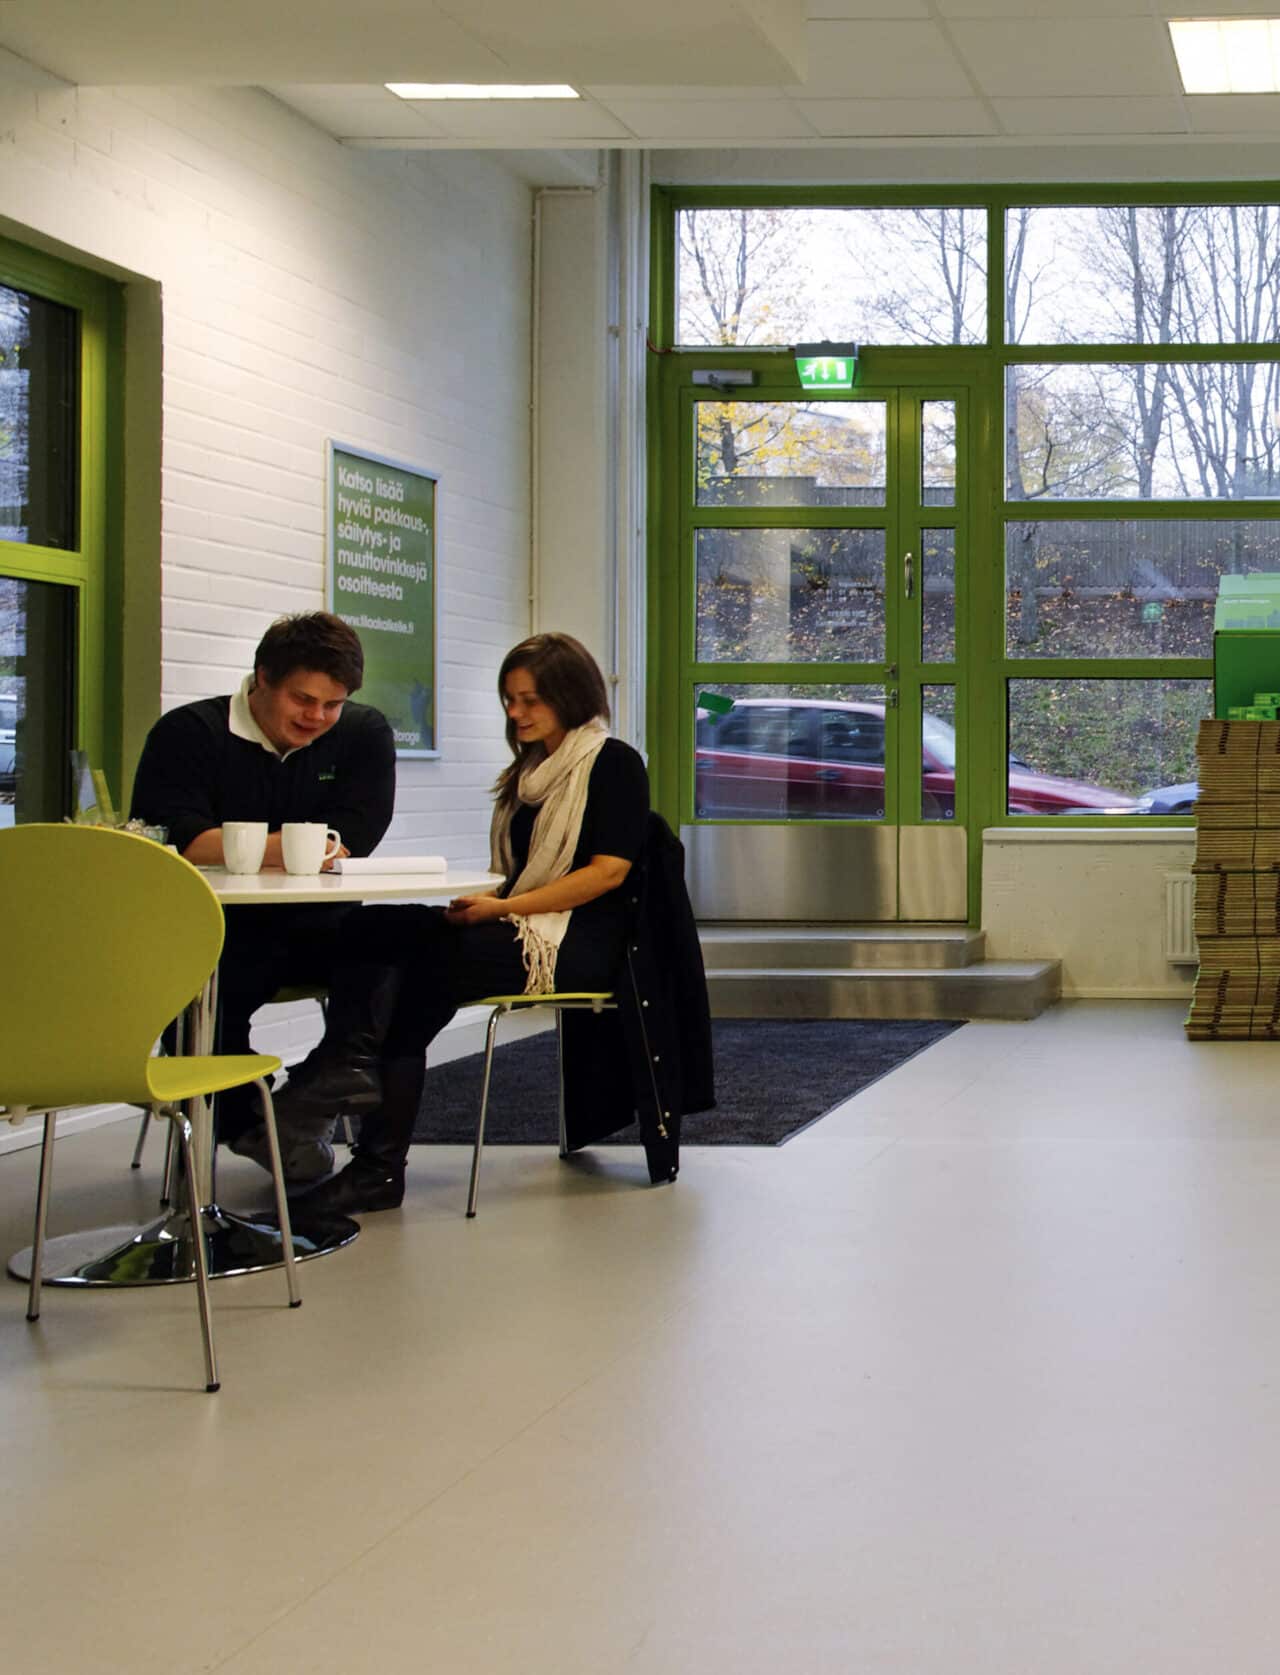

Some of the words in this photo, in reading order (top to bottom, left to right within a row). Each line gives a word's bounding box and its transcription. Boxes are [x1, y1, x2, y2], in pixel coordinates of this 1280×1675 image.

[338, 466, 373, 493] Katso
[376, 477, 404, 503] lisää
[338, 492, 371, 518] hyviä
[374, 506, 429, 536] pakkaus-,
[338, 518, 387, 549] säilytys-
[388, 531, 402, 554] ja
[338, 549, 428, 584] muuttovinkkejä
[338, 576, 403, 601] osoitteesta
